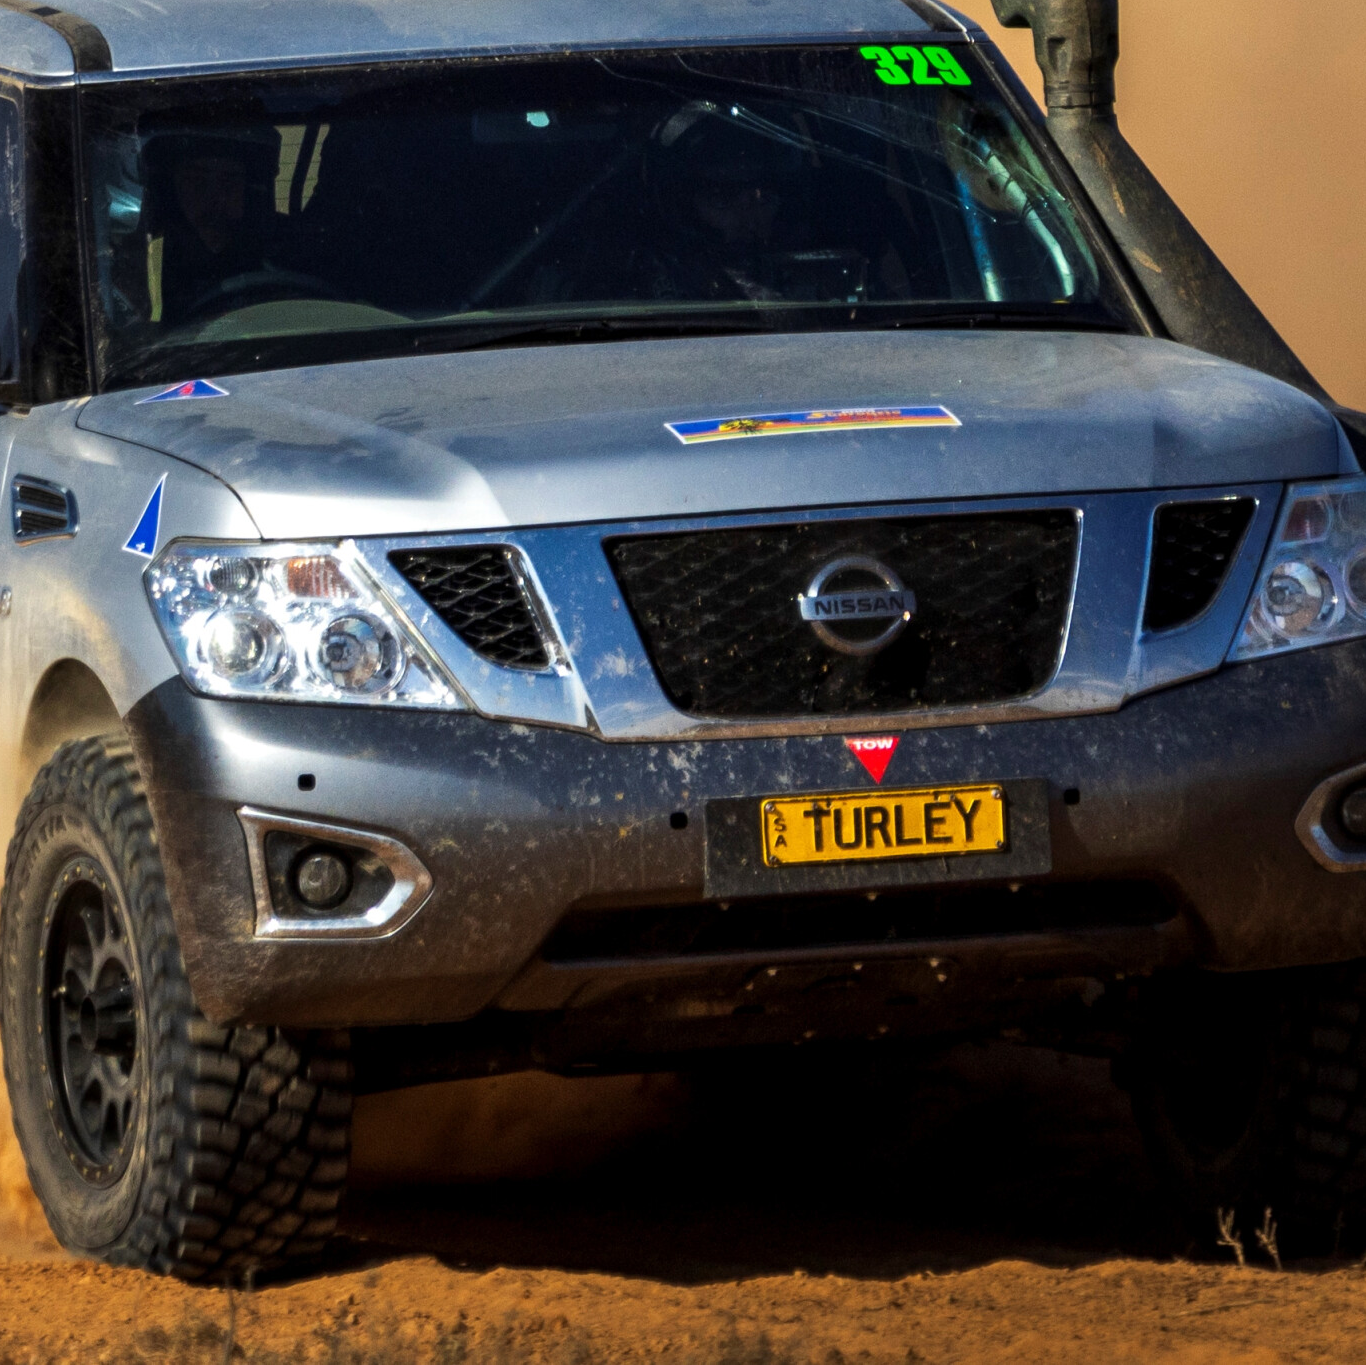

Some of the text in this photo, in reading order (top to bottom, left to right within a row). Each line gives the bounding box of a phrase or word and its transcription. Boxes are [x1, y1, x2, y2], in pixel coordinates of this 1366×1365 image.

[859, 45, 973, 86] 329
[813, 595, 906, 616] NISSAN
[852, 738, 895, 751] TOW
[802, 797, 982, 853] TURLEY
